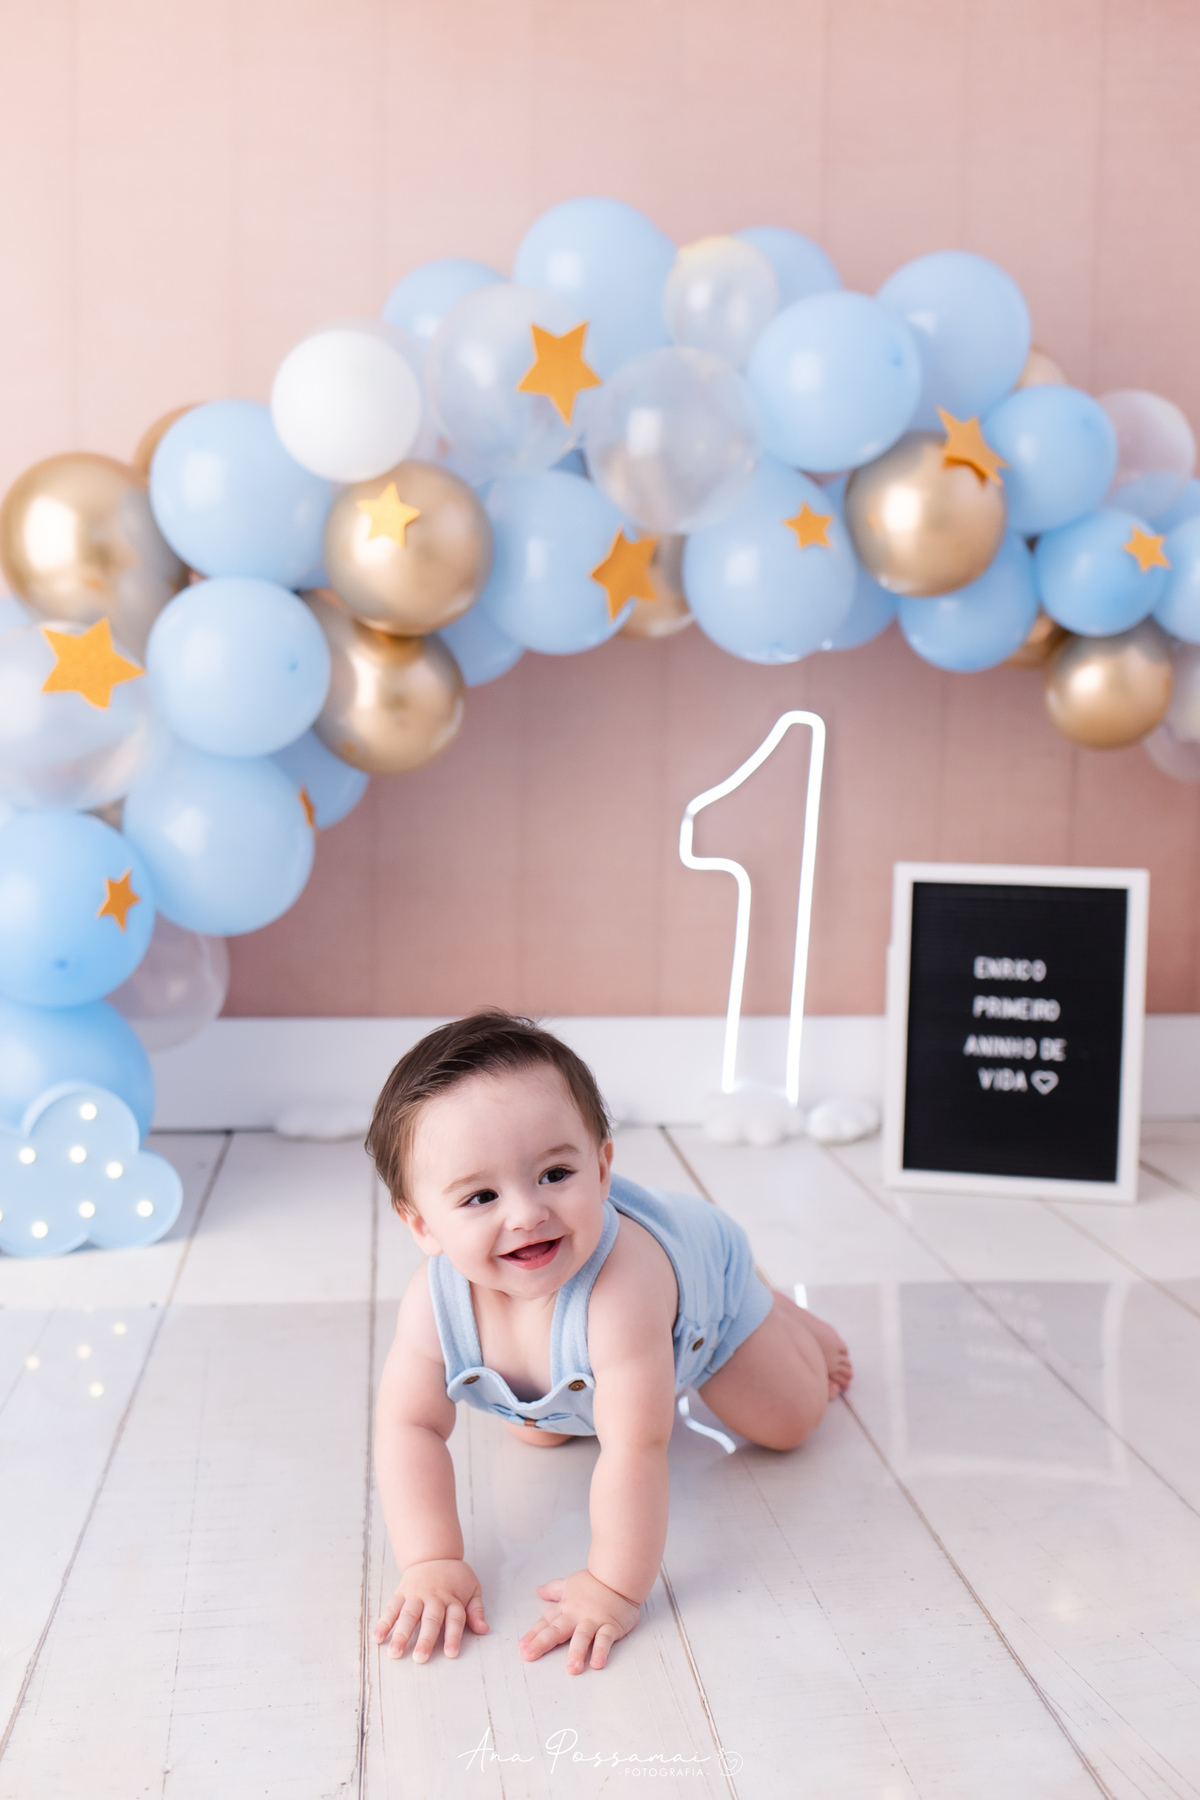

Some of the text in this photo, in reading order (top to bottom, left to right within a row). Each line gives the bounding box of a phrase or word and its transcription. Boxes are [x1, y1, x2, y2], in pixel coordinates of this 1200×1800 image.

[974, 956, 1046, 981] ENRICO
[973, 995, 1060, 1021] PRIMEIRO
[963, 1034, 1066, 1061] ANINHO DE
[978, 1067, 1028, 1091] VIDA
